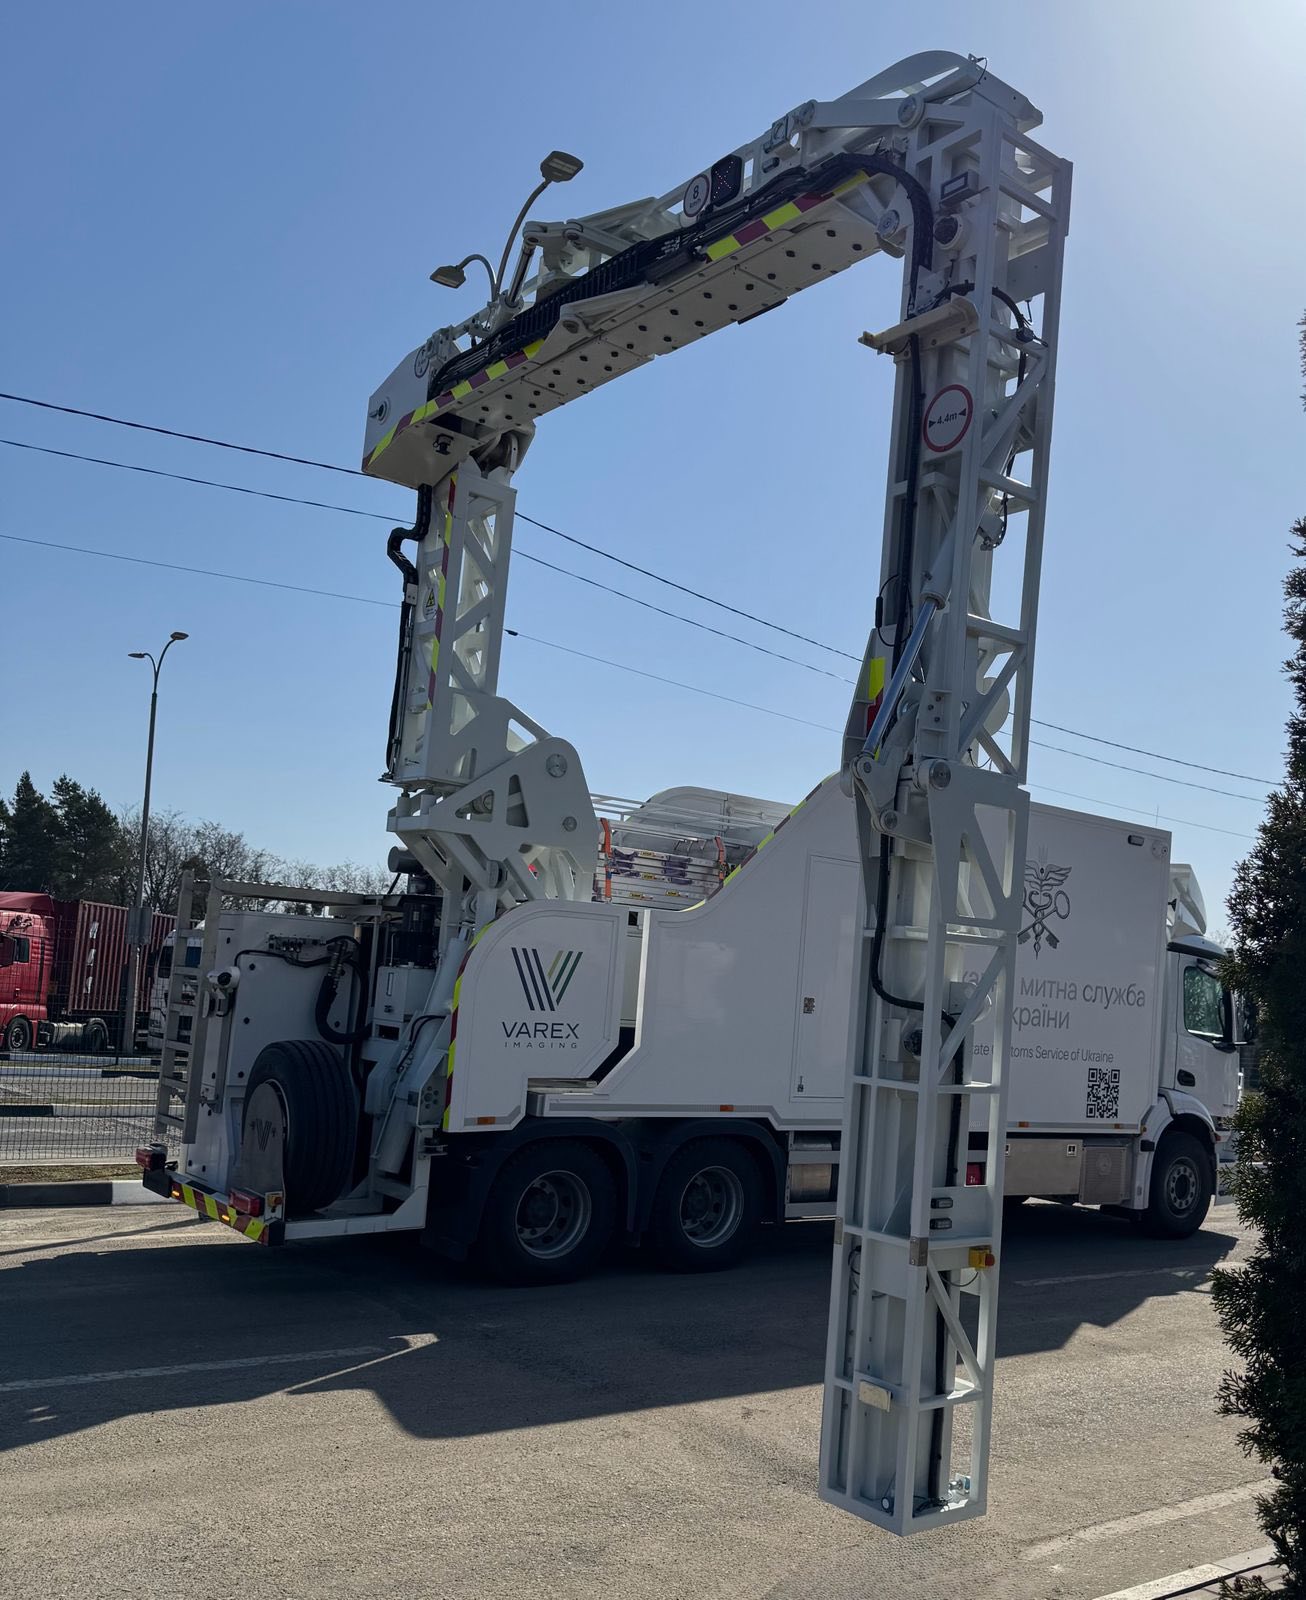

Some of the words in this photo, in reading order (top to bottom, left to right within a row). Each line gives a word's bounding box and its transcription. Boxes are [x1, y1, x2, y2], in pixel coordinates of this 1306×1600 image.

[692, 185, 699, 199] 8
[937, 413, 958, 424] 4.4m
[1020, 978, 1077, 1001] митна
[1082, 983, 1145, 1010] служба
[1012, 1003, 1070, 1031] країни
[502, 1021, 579, 1039] VAREX
[973, 1044, 990, 1056] ate
[1035, 1045, 1069, 1061] Service
[1070, 1048, 1080, 1061] of
[1081, 1048, 1114, 1063] Ukraine
